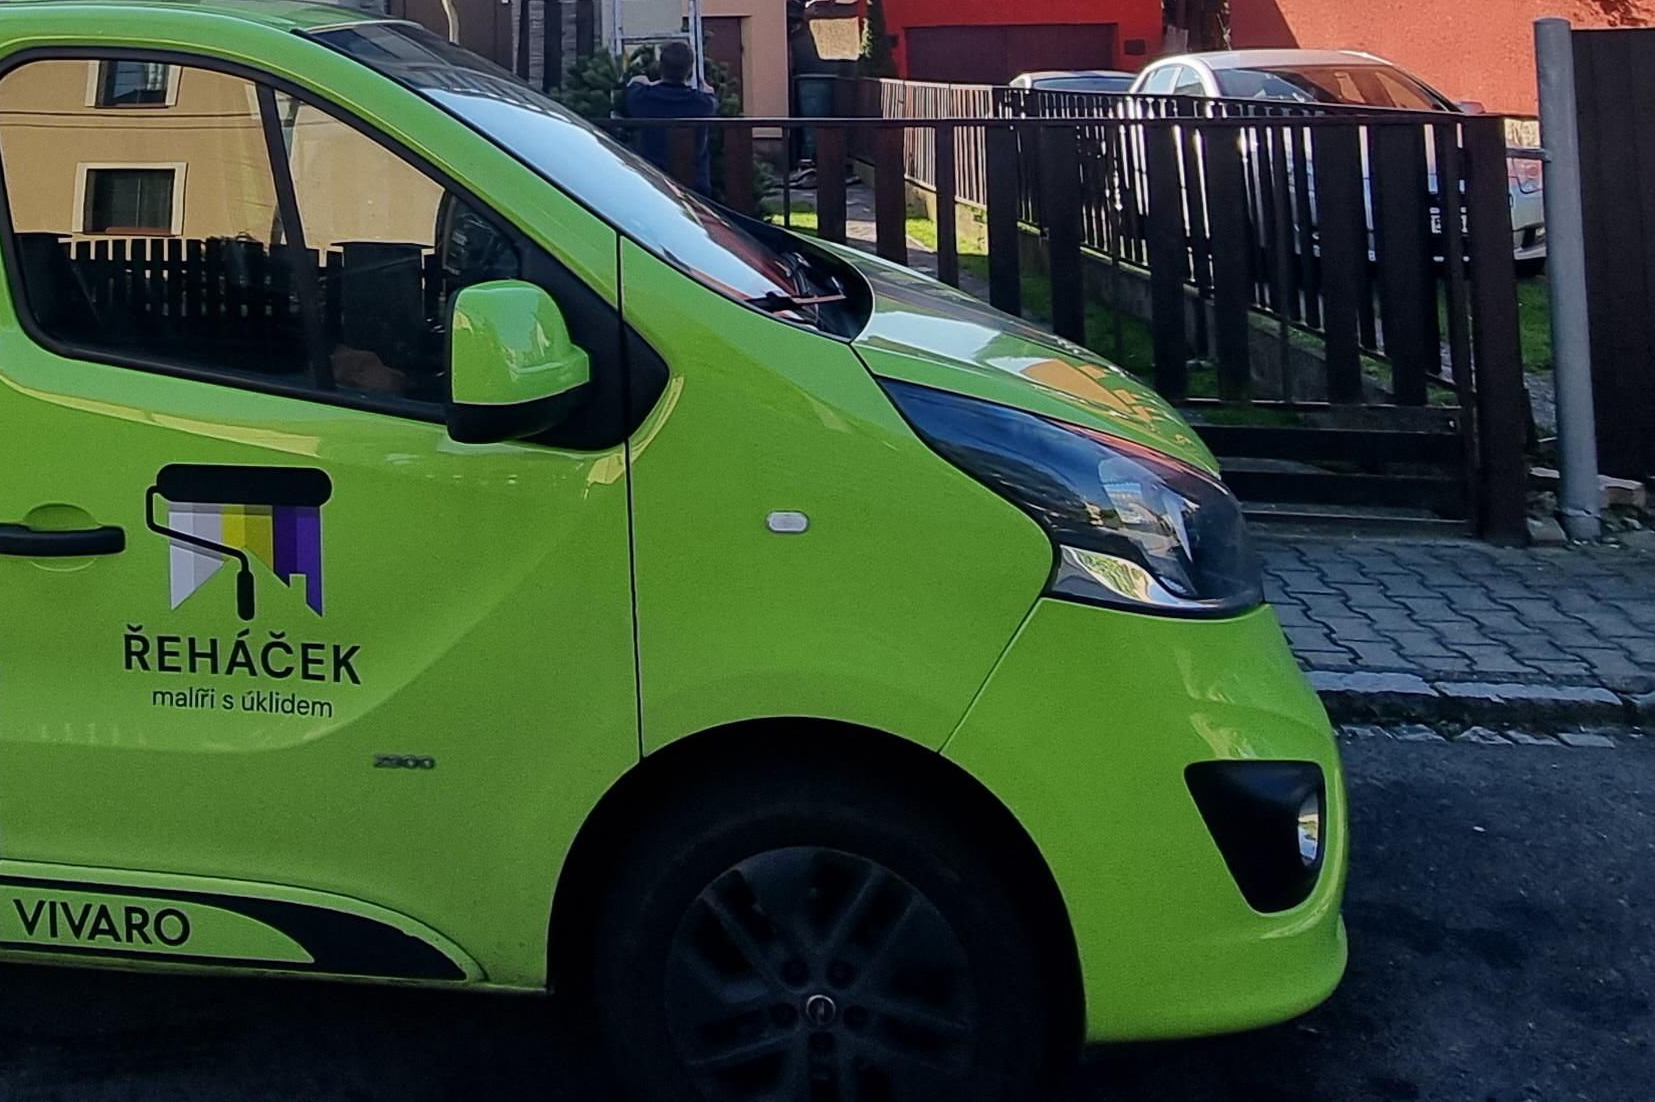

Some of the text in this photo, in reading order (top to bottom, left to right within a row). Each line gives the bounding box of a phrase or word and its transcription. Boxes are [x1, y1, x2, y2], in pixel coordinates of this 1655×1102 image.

[124, 624, 361, 685] ŘEHÁČEK
[152, 687, 332, 718] malíři s úklidem
[13, 899, 190, 946] VIVARO
